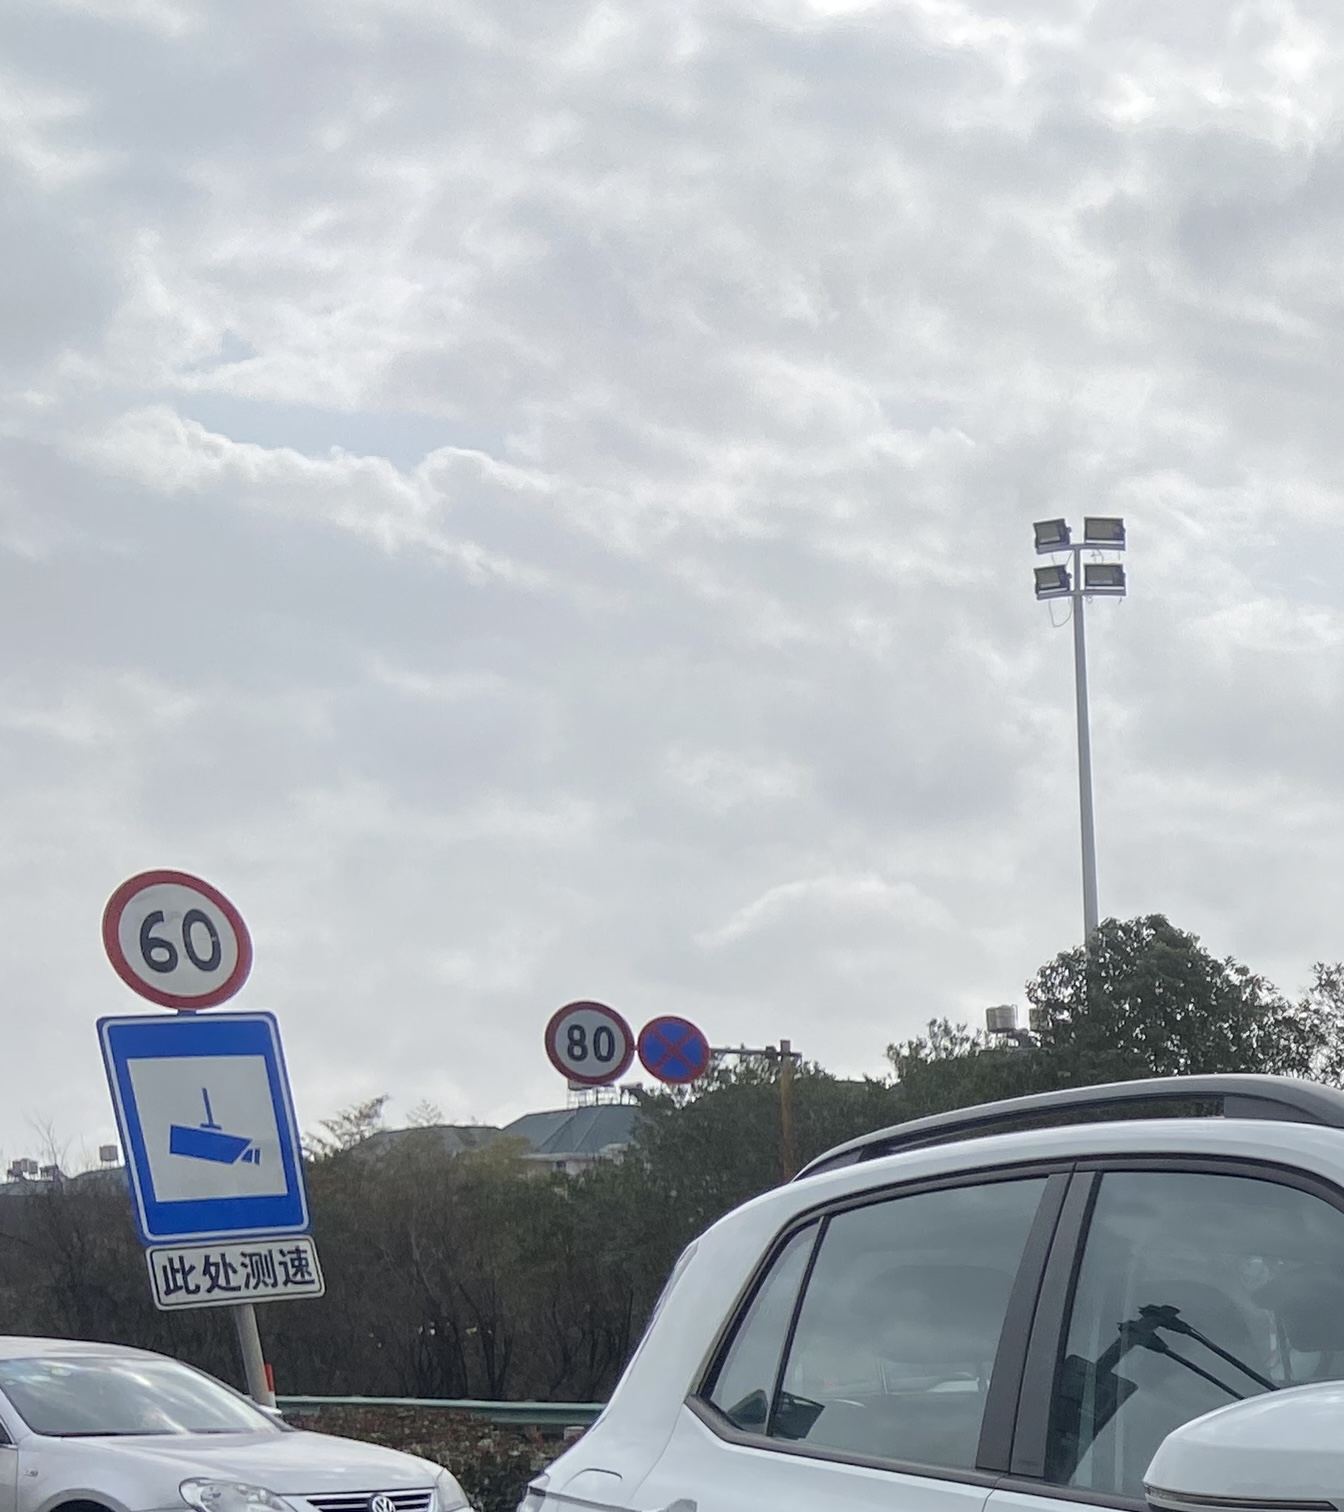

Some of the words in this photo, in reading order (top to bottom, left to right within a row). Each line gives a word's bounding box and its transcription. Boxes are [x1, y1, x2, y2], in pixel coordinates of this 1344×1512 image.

[139, 908, 222, 974] 60
[567, 1024, 616, 1063] 80
[161, 1245, 316, 1297] 此处测速
